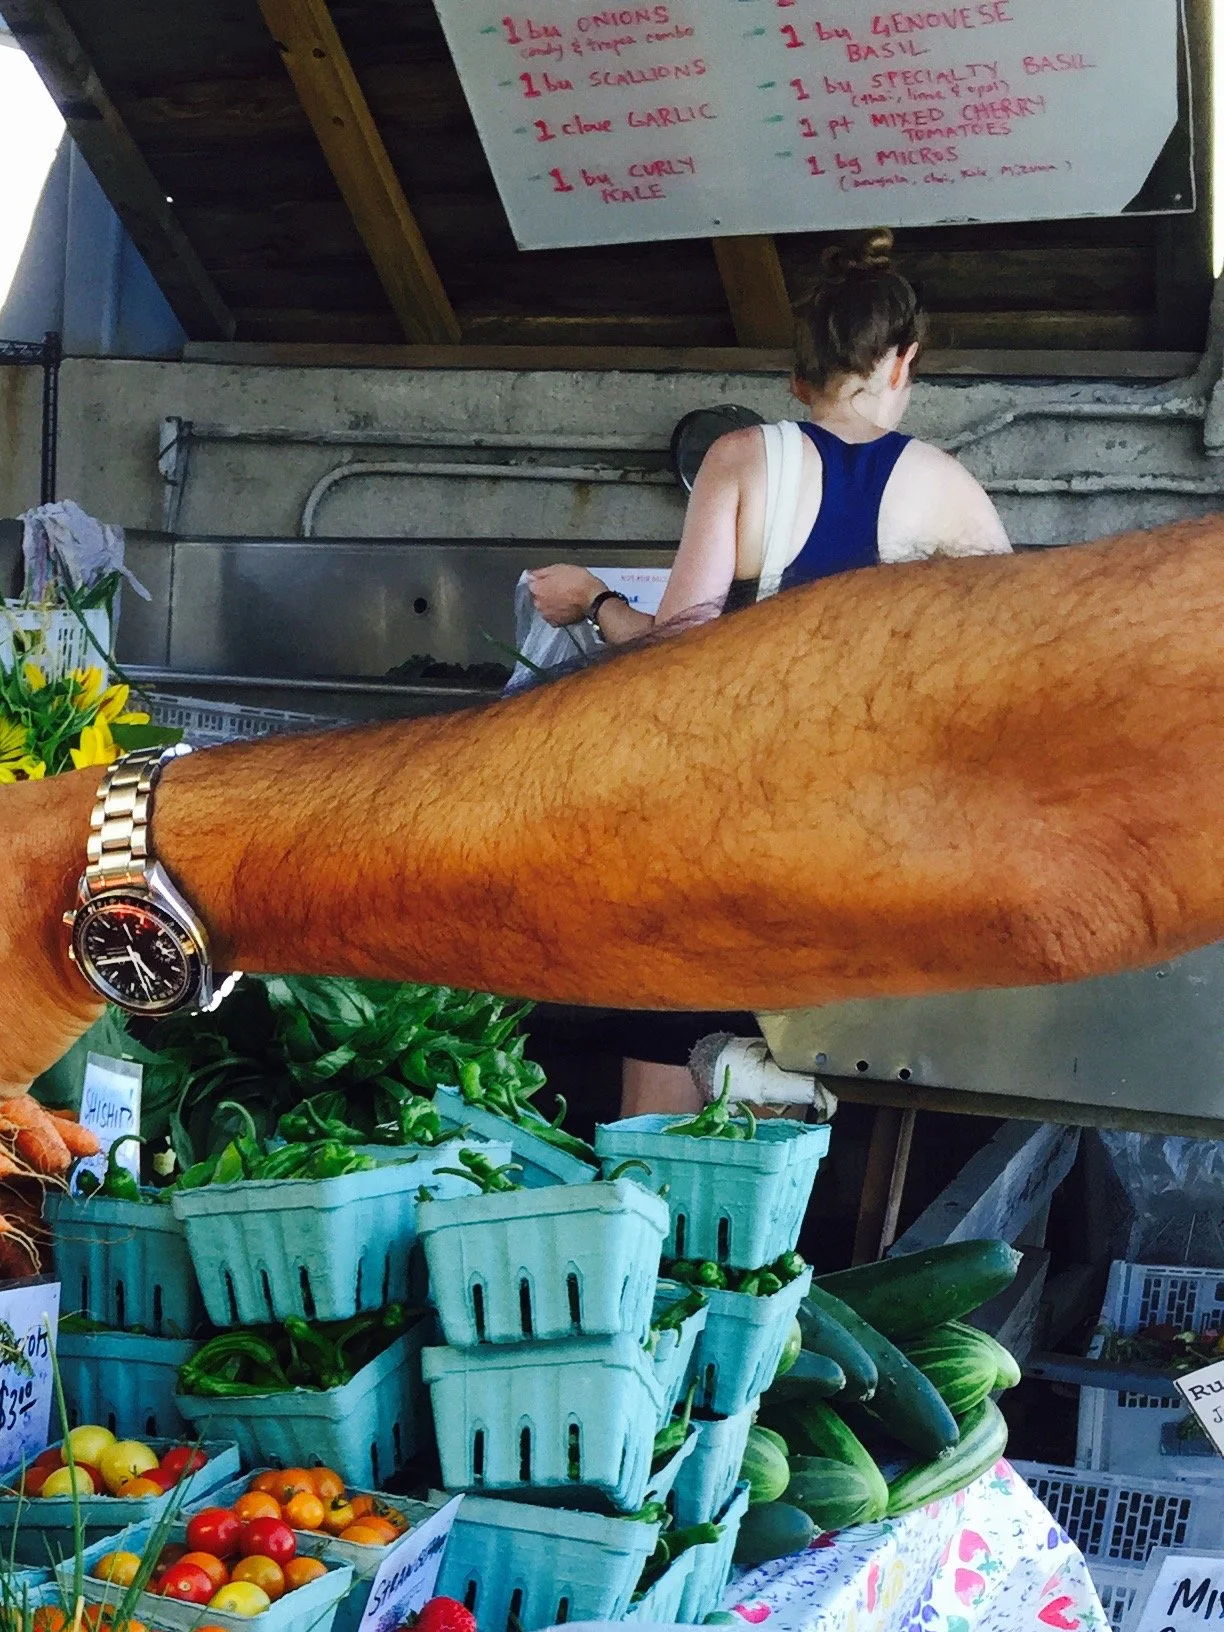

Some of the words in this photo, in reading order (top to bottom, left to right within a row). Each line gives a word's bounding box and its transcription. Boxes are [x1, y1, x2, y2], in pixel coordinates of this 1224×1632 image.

[503, 16, 523, 44] 1
[578, 6, 669, 32] ONIONS
[780, 24, 805, 48] 1
[870, 1, 1015, 38] GENOVESE
[846, 40, 931, 63] BASIL
[519, 72, 541, 97] 1
[589, 59, 706, 87] SCALLIONS
[789, 78, 810, 100] 1
[872, 61, 999, 89] SPECIALTY
[1022, 53, 1097, 76] BASIL
[533, 119, 556, 142] 1
[562, 114, 613, 135] clove
[628, 103, 718, 128] GARLIC
[799, 117, 819, 138] 1
[828, 114, 854, 140] pt
[871, 108, 944, 127] MIXED
[962, 95, 1048, 121] CHERRY
[902, 122, 1012, 142] TOMATOES
[549, 167, 574, 192] 1
[628, 156, 697, 177] CURLY
[804, 155, 826, 176] 1
[876, 146, 960, 167] MICROS
[600, 183, 666, 204] KALE
